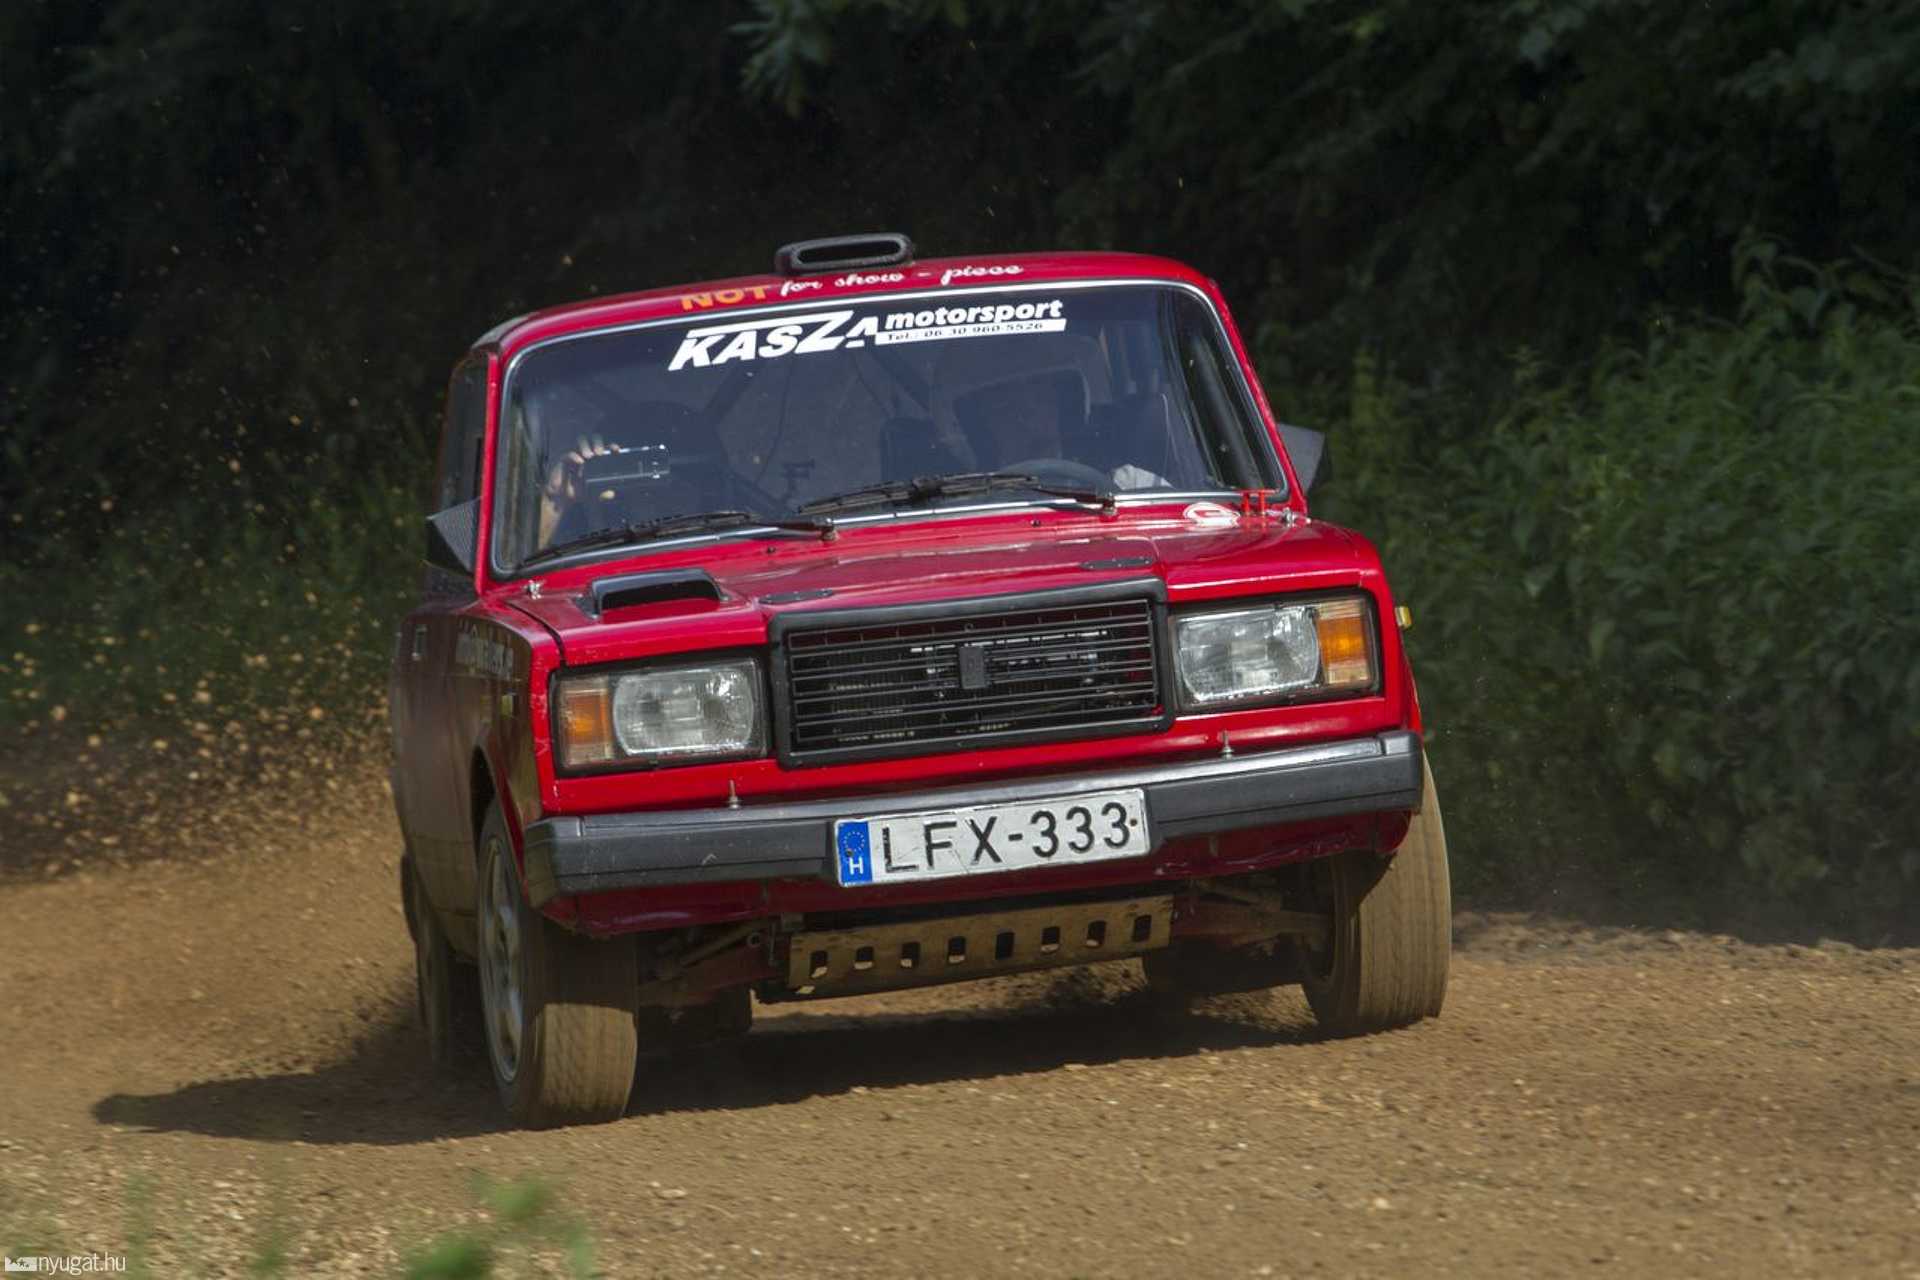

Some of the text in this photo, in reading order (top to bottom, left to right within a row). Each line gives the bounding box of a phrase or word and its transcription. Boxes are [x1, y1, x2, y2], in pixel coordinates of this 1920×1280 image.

[680, 284, 770, 311] NOT
[780, 280, 823, 297] for
[834, 272, 905, 288] show
[940, 264, 1025, 286] piece
[668, 299, 1064, 371] KASZA motorsport
[924, 329, 943, 338] 06
[882, 801, 1131, 874] LFX-333
[848, 856, 864, 875] H
